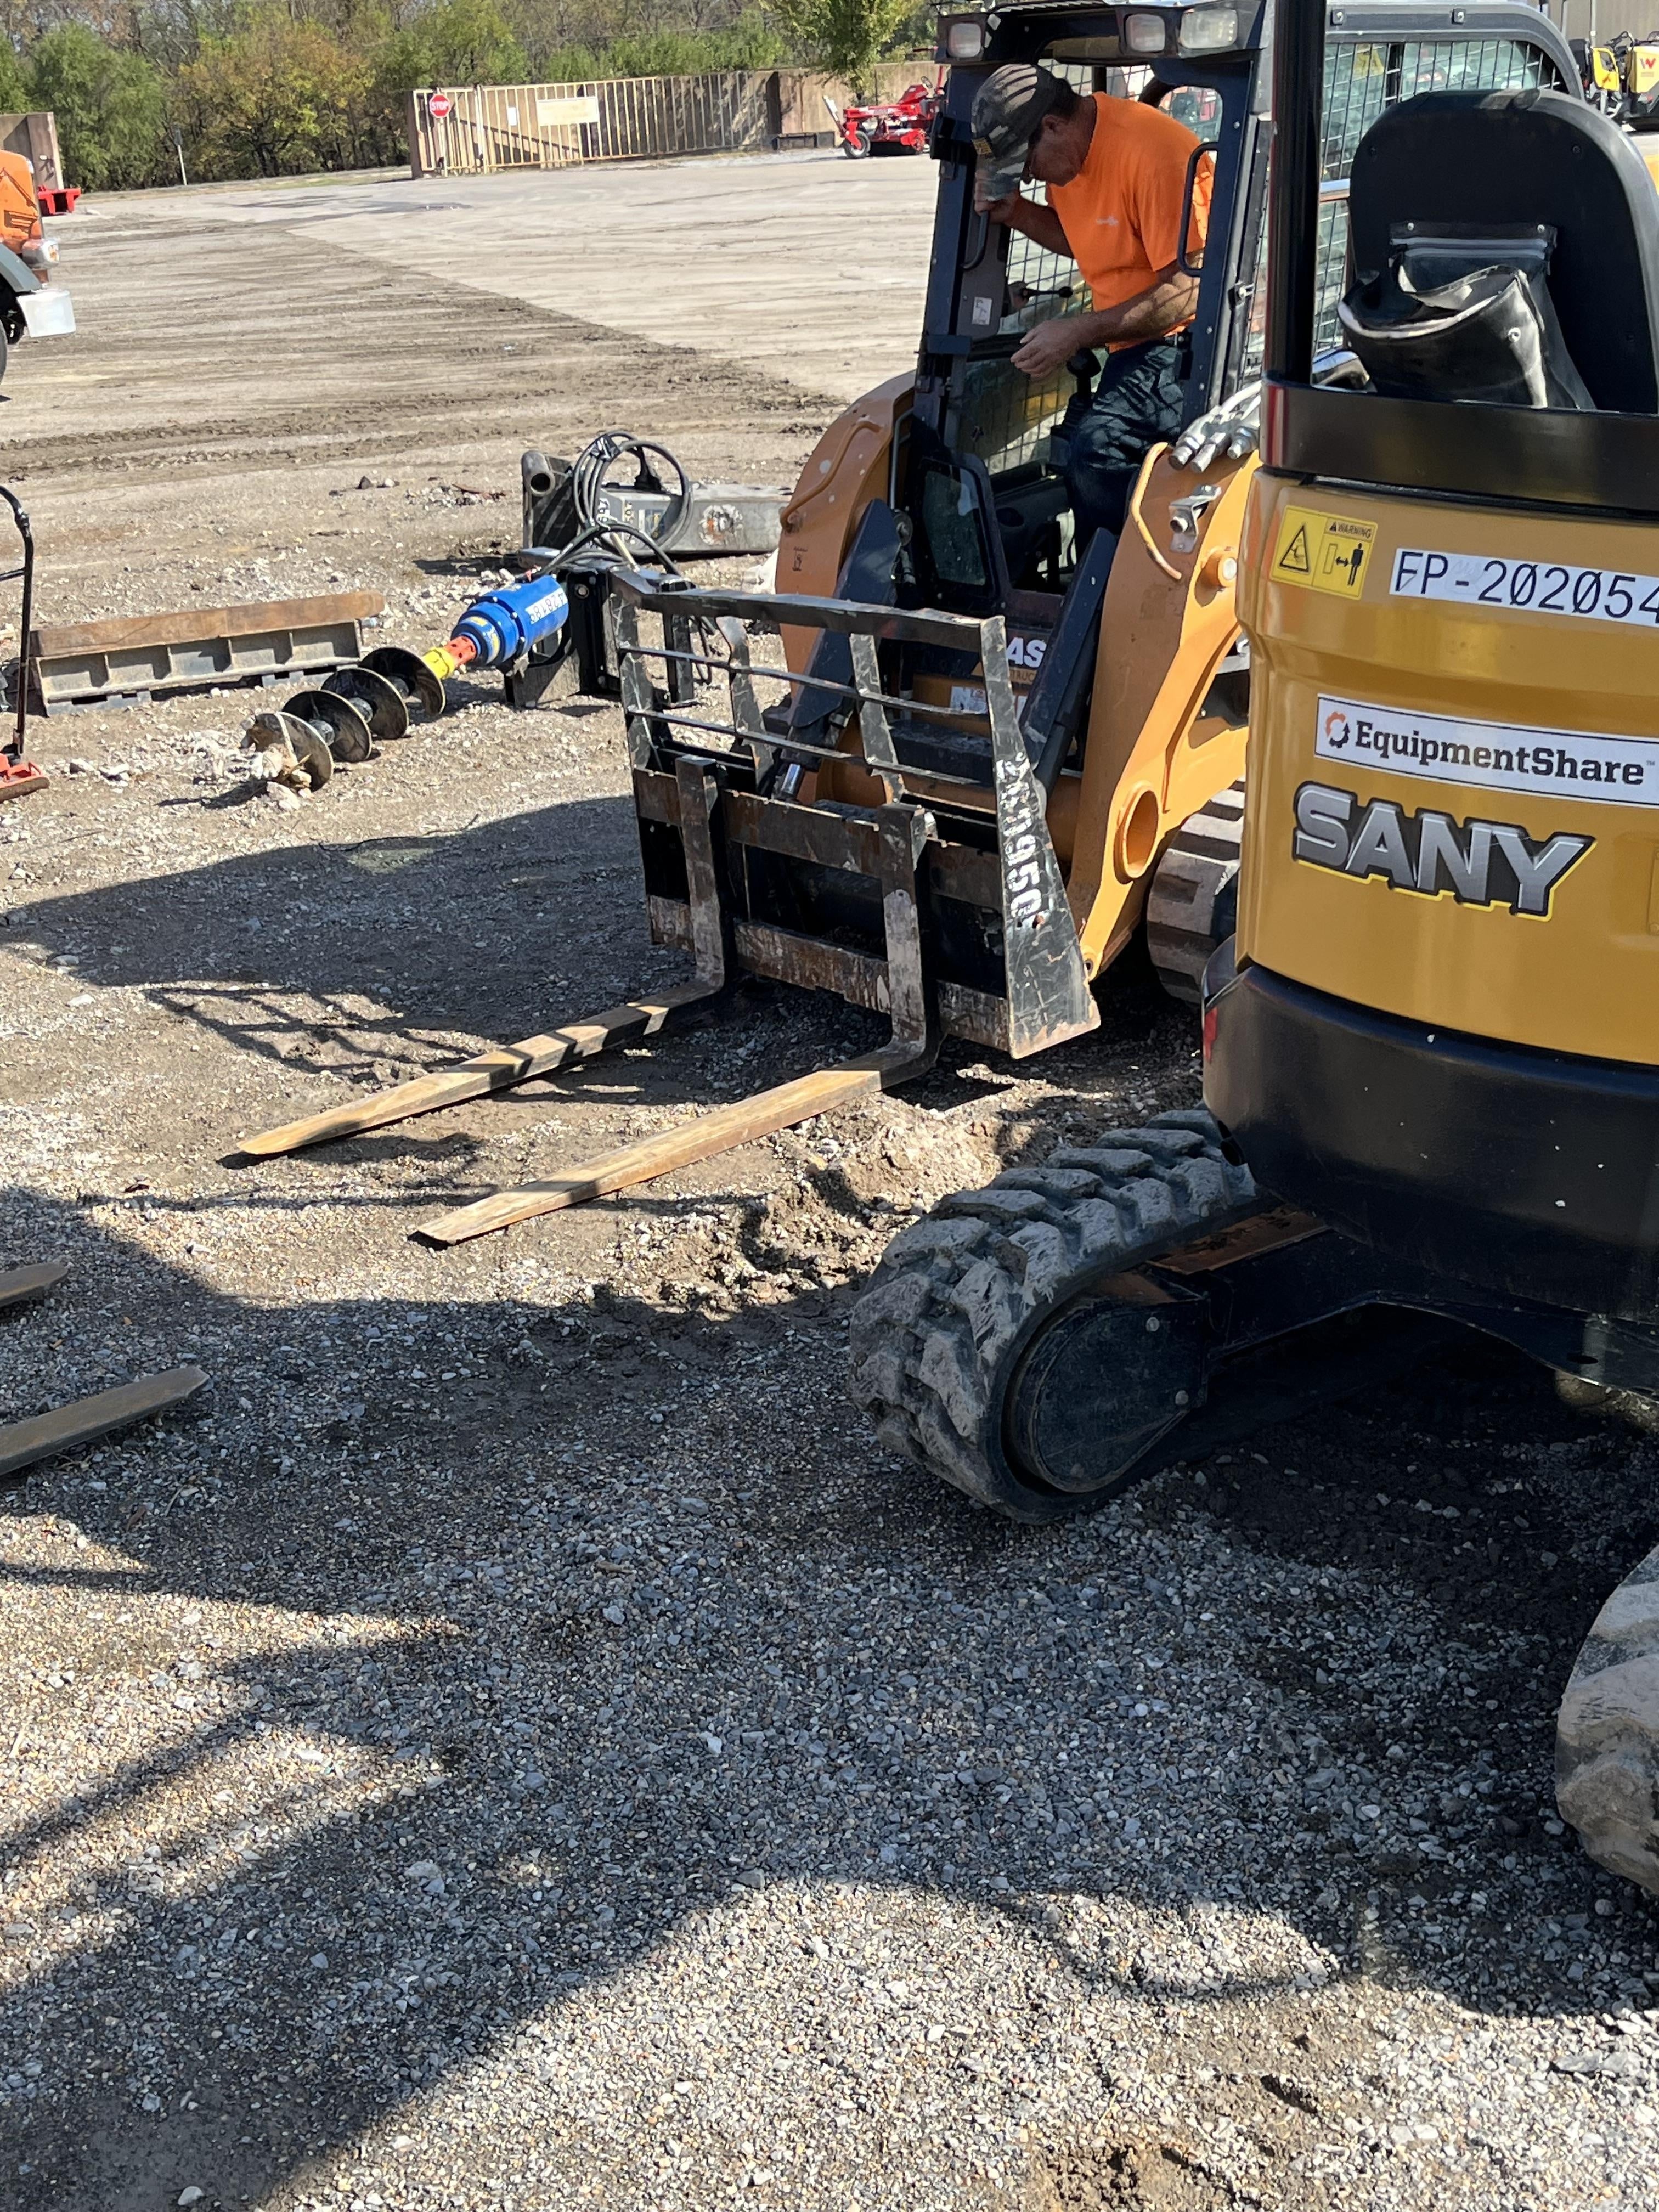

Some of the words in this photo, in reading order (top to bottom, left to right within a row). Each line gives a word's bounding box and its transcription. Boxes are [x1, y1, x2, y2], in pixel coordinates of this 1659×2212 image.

[431, 101, 449, 111] STOP
[1339, 523, 1372, 539] WARNING
[1006, 637, 1047, 668] AS
[1356, 720, 1644, 785] EquipmentShare
[1293, 781, 1595, 917] SANY
